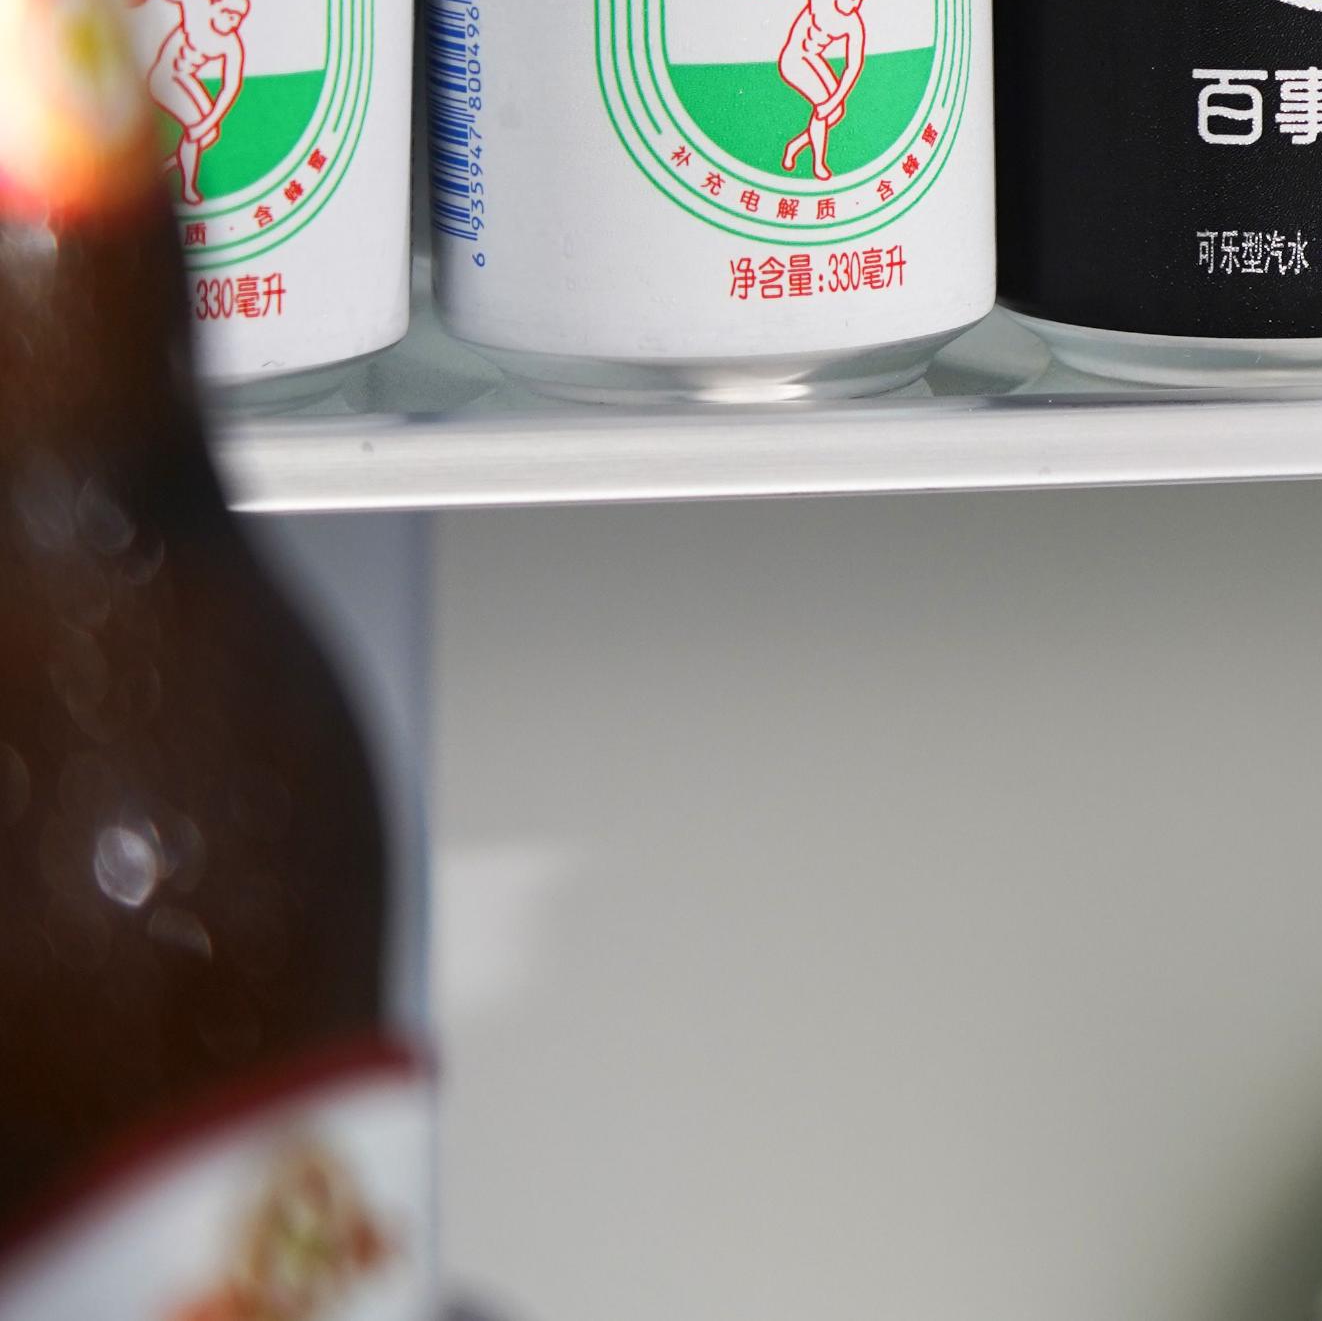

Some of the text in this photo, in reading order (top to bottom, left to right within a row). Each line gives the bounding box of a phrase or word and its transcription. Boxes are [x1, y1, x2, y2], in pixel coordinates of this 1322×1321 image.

[465, 5, 486, 268] 6 935947 800496
[729, 245, 908, 300] 净含量:330毫升
[1196, 230, 1310, 275] 可乐型汽水
